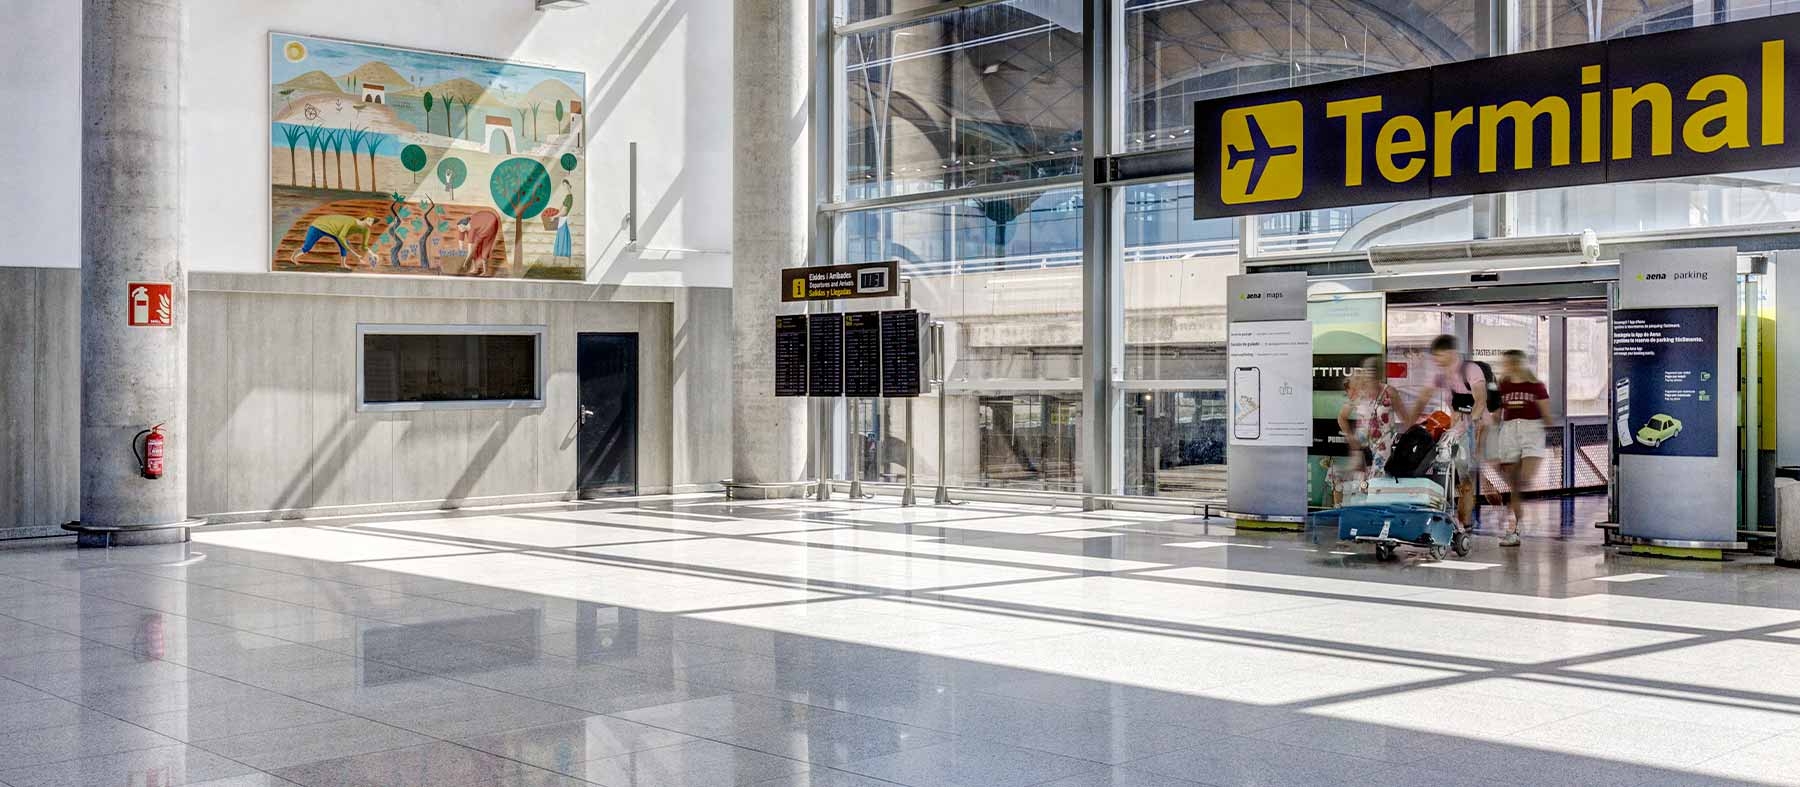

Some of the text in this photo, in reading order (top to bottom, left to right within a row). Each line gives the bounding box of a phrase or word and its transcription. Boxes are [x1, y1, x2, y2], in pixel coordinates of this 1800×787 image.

[1326, 39, 1785, 187] Terminal
[1674, 271, 1708, 280] parking
[809, 281, 831, 289] Departures
[808, 289, 826, 297] Salidas
[831, 288, 852, 297] Llegadas
[1656, 335, 1675, 344] parking
[1475, 348, 1491, 357] TASTES
